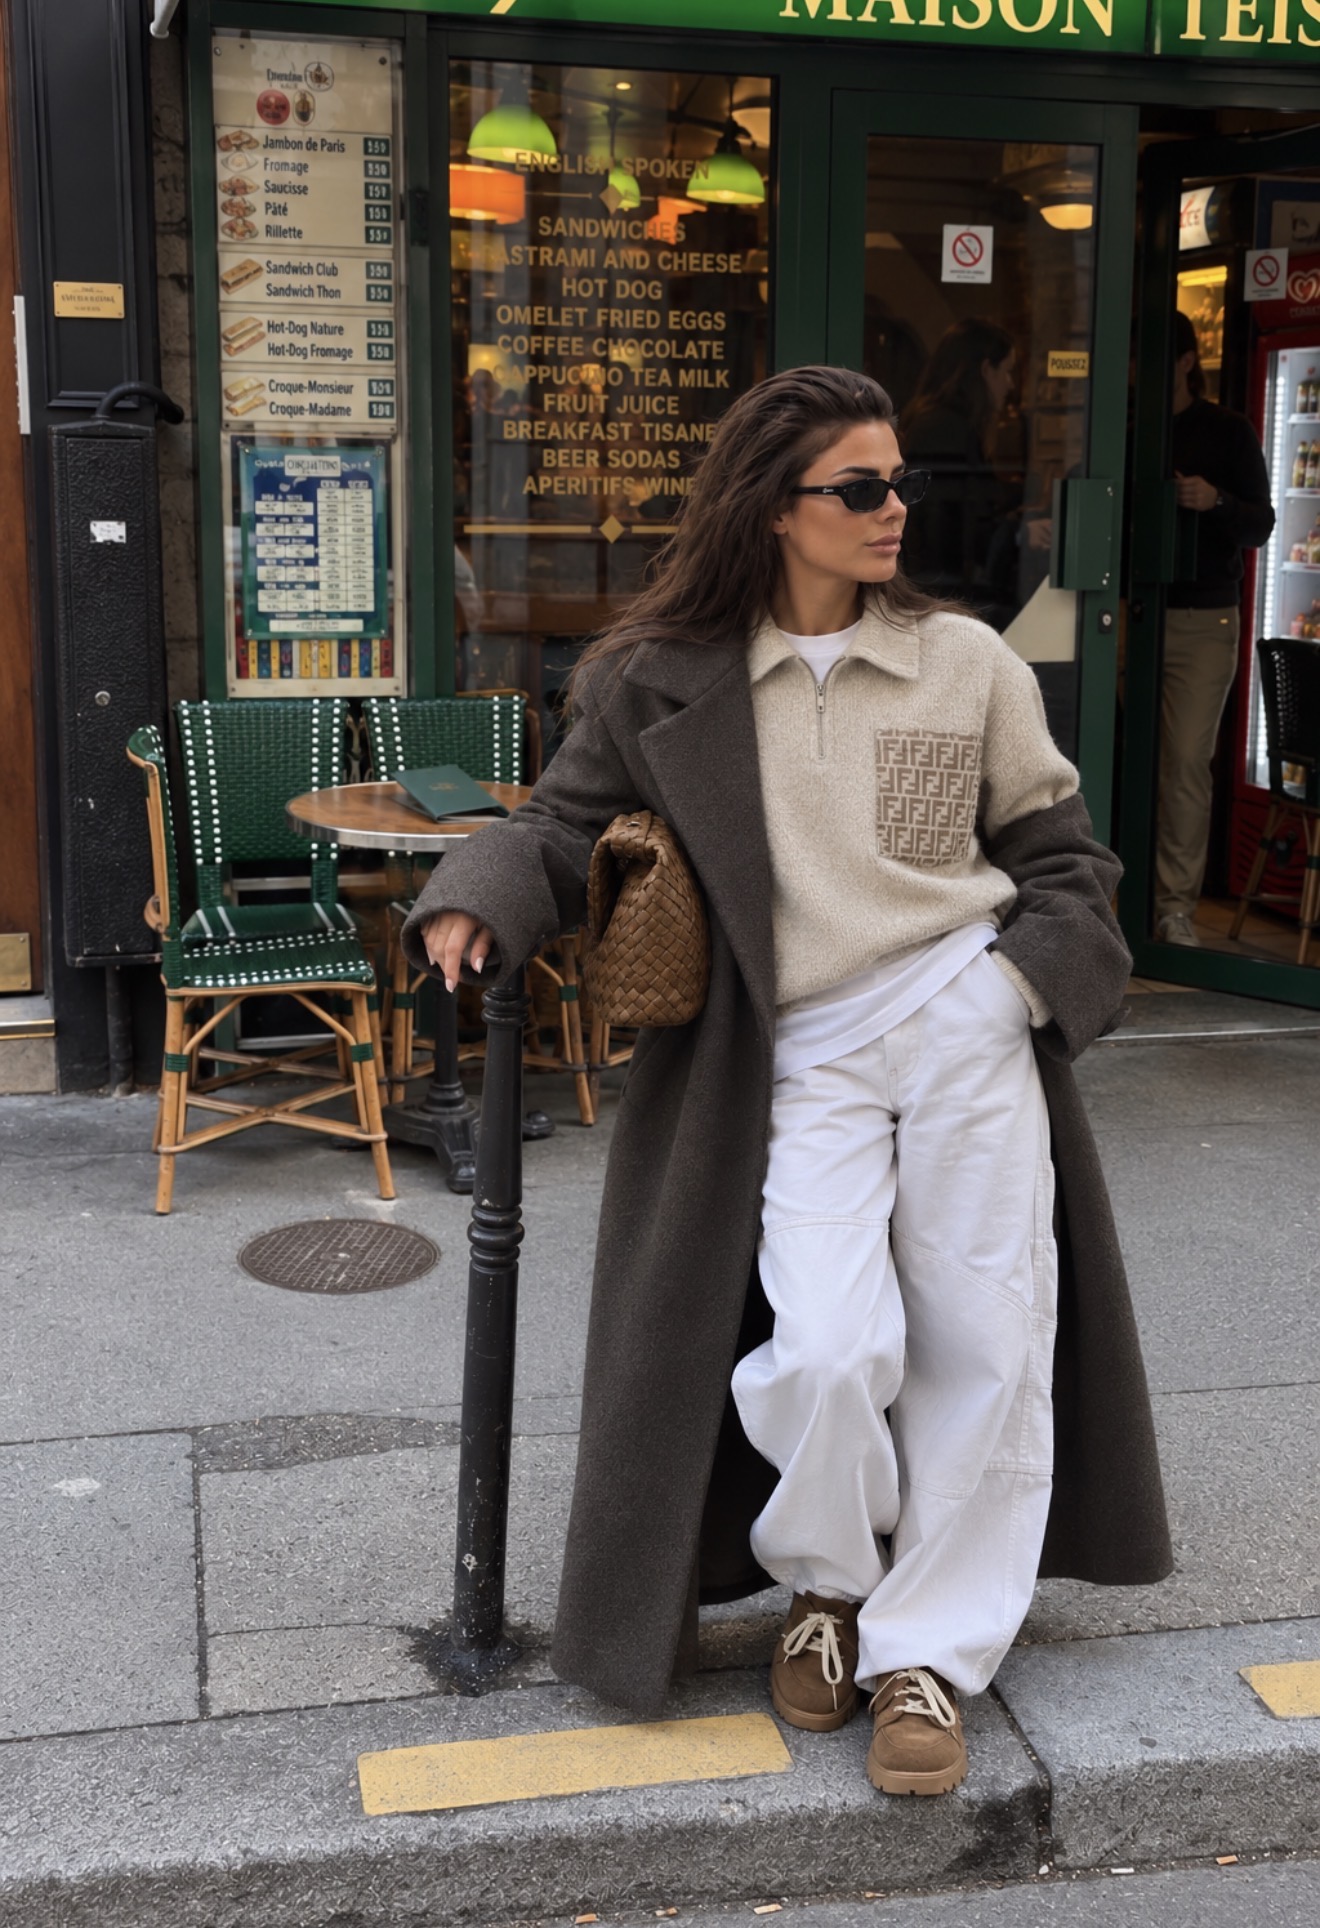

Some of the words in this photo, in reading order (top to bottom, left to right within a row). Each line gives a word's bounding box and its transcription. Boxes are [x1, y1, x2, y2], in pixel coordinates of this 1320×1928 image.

[263, 135, 303, 150] Jambon
[305, 137, 318, 151] de
[320, 138, 345, 153] Paris
[264, 158, 309, 175] Fromage
[515, 152, 614, 176] ENGLISH
[622, 157, 709, 180] SPOKEN
[264, 180, 308, 194] Saucisse
[265, 201, 288, 216] Pâté
[265, 224, 303, 239] Rillette
[538, 217, 686, 242] SANDWICHES
[266, 260, 313, 276] Sandwich
[316, 262, 338, 277] Club
[497, 245, 595, 269] ASTRAMI
[604, 250, 650, 270] AND
[658, 251, 742, 274] CHEESE
[266, 283, 314, 298] Sandwich
[317, 285, 341, 299] Thon
[562, 278, 608, 299] HOT
[616, 280, 662, 300] DOG
[496, 305, 588, 327] OMELET
[597, 308, 661, 329] FRIED
[668, 311, 726, 331] EGGS
[267, 320, 307, 337] Hot-Dog
[310, 322, 344, 336] Nature
[268, 343, 308, 359] Hot-Dog
[310, 344, 353, 361] Fromage
[497, 336, 584, 357] COFFEE
[593, 338, 725, 360] CHOCOLATE
[268, 379, 353, 395] Croque-Monsieur
[630, 368, 672, 387] TEA
[679, 369, 729, 388] MILK
[269, 402, 352, 419] Croque-Madame
[543, 394, 609, 414] FRUIT
[616, 396, 680, 415] JUICE
[503, 420, 633, 442] BREAKFAST
[543, 449, 600, 469] BEER
[607, 450, 680, 469] SODAS
[522, 476, 636, 496] APERITIFS
